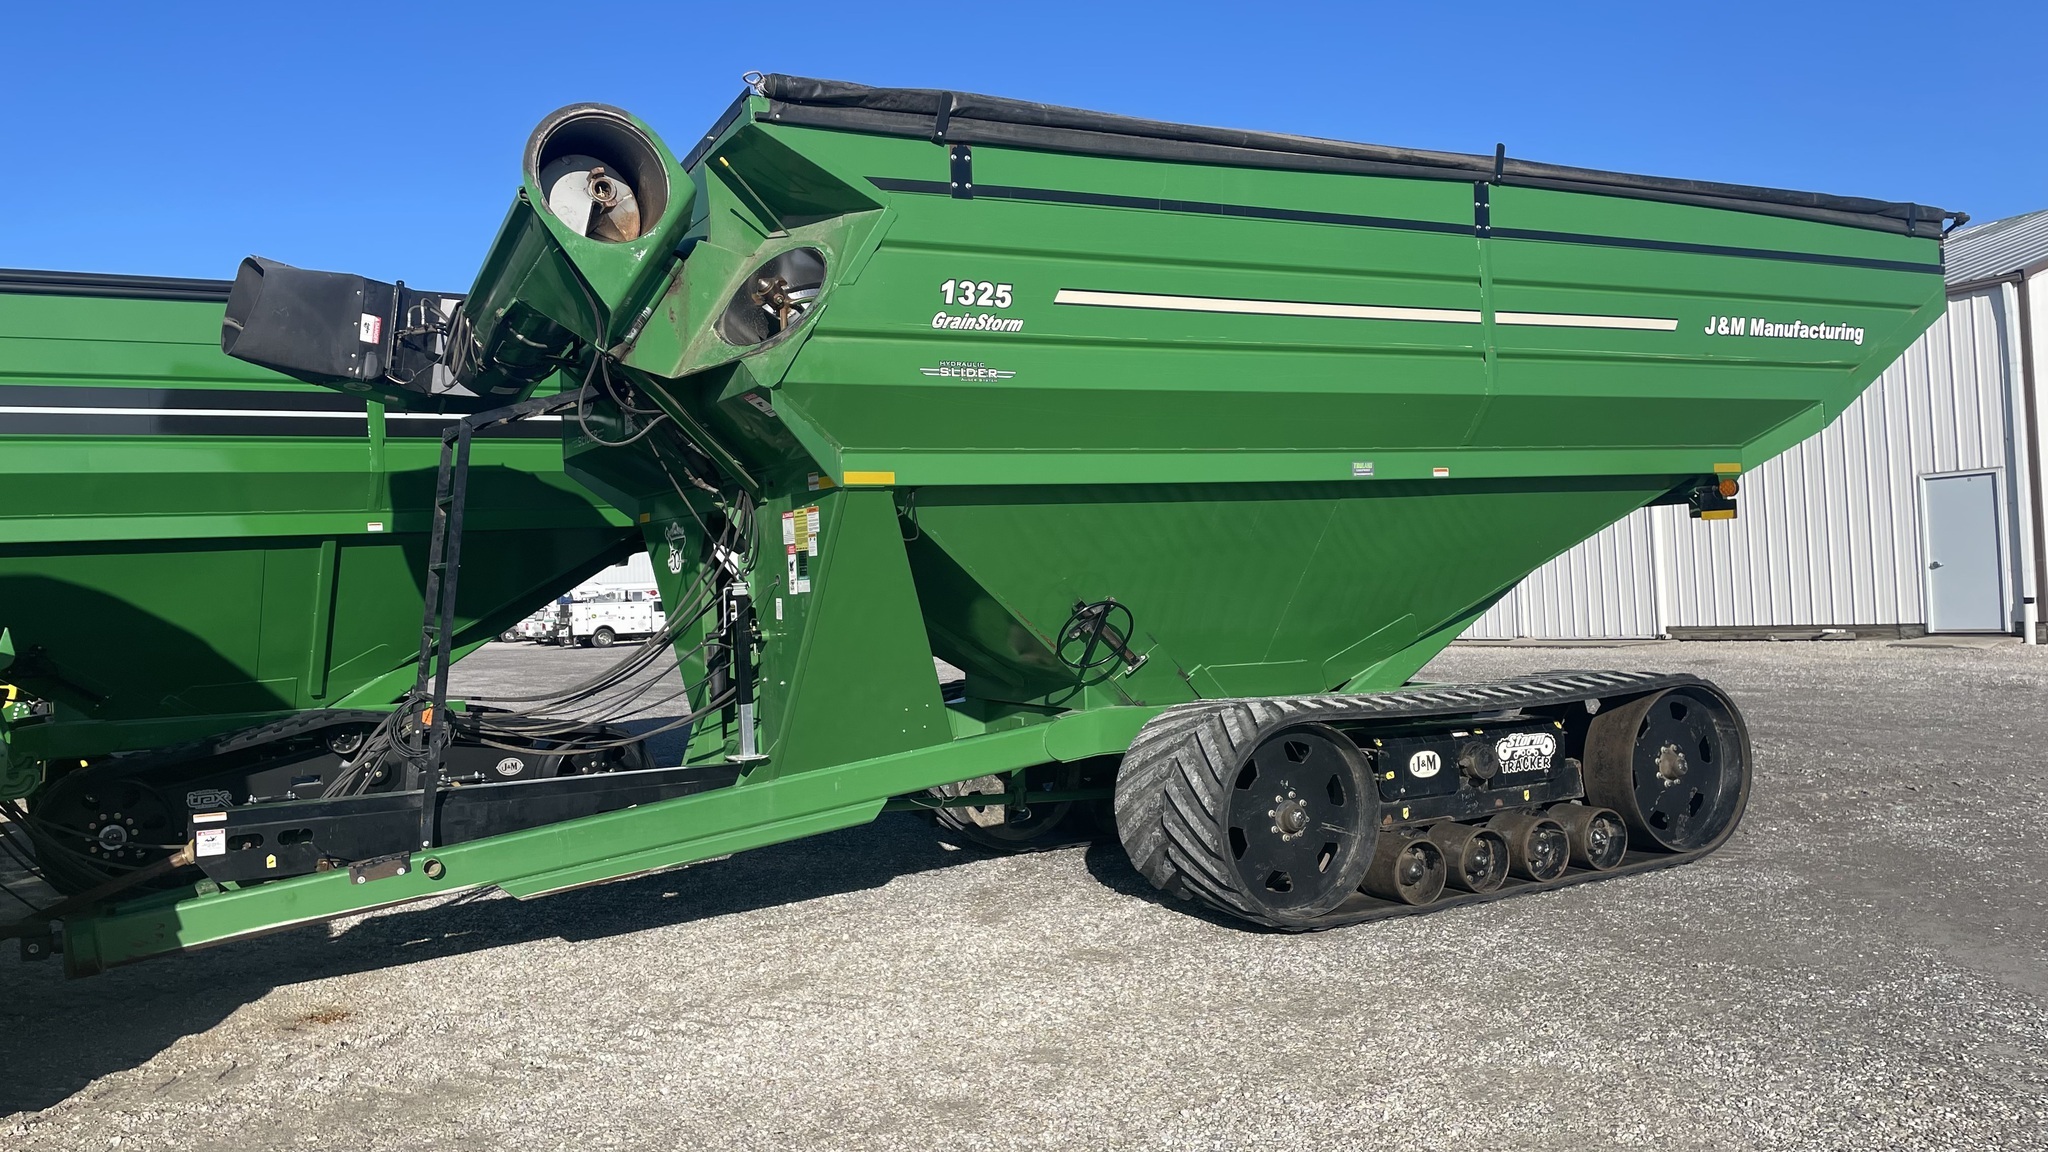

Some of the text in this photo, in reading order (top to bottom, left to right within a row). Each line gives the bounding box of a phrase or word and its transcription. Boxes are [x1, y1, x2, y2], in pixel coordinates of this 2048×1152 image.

[940, 279, 1013, 309] 1325
[931, 310, 1024, 332] GrainStorm
[1704, 315, 1865, 346] J&M Manufacturing
[939, 367, 998, 379] SLIDER
[1507, 733, 1546, 749] Storm
[501, 761, 518, 772] J&M
[1412, 753, 1437, 773] J&M
[1500, 756, 1551, 774] TRACKER
